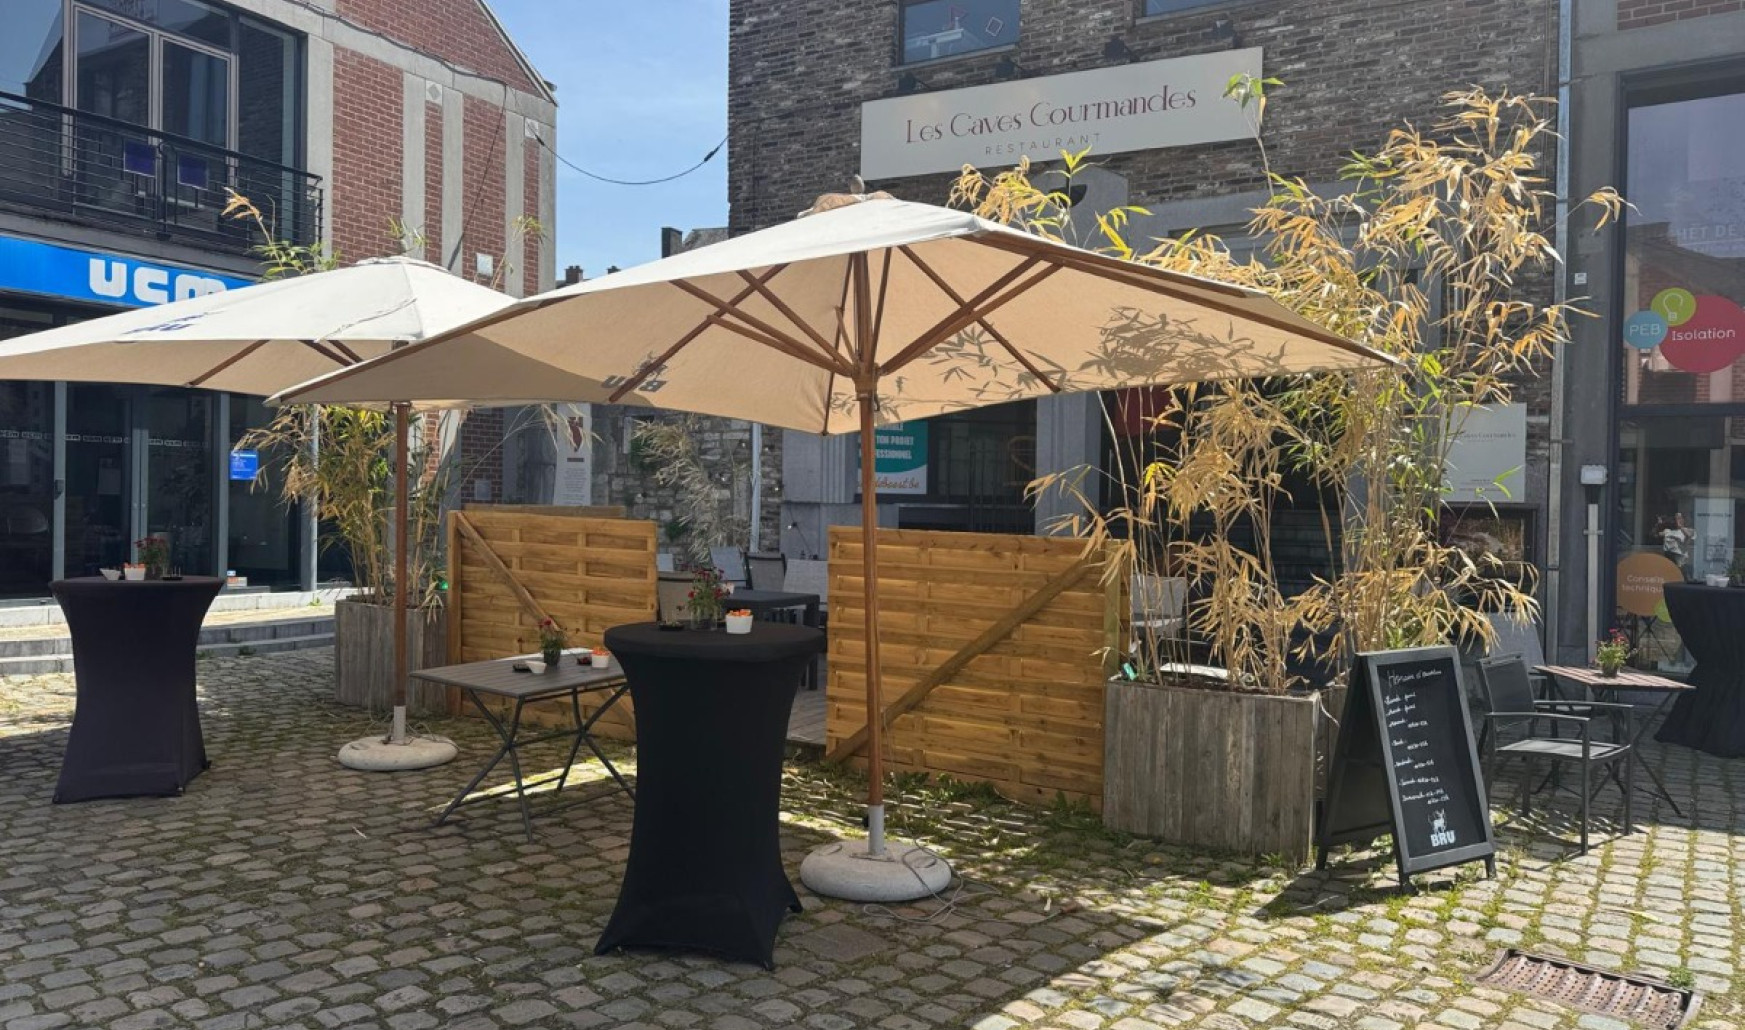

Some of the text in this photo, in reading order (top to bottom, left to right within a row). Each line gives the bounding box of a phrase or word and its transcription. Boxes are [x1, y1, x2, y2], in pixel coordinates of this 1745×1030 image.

[905, 85, 1197, 144] Les Caves Gourmandes
[985, 133, 1101, 156] RESTAURANT
[1629, 323, 1661, 336] PEB
[1672, 327, 1736, 341] Isolation
[1622, 583, 1664, 593] techniqu
[1430, 830, 1456, 847] BRU
